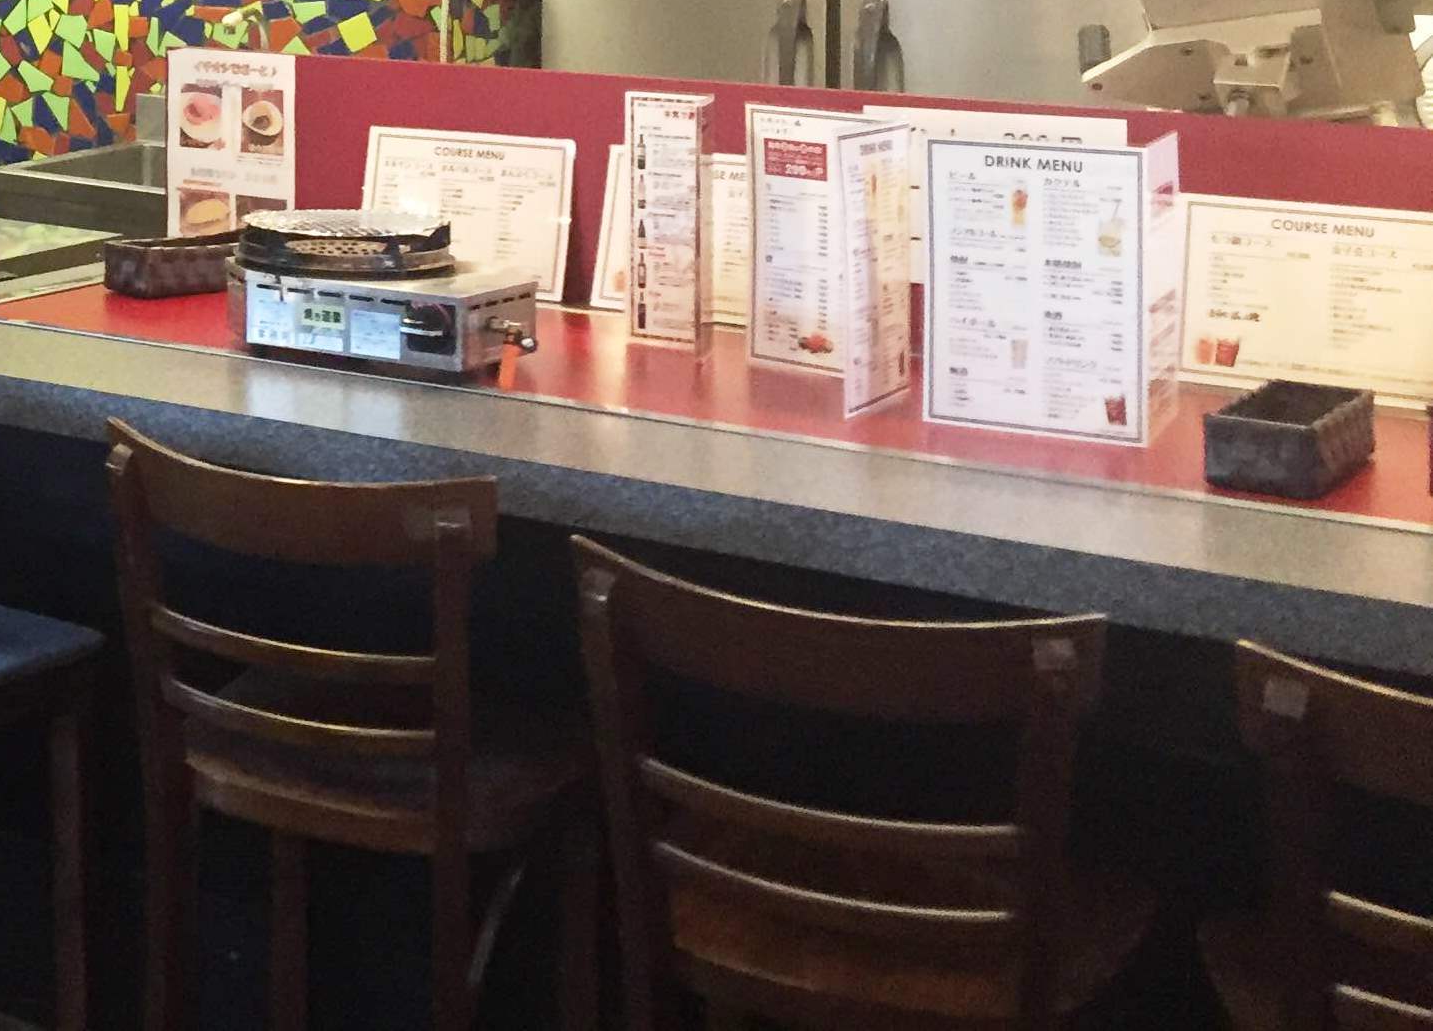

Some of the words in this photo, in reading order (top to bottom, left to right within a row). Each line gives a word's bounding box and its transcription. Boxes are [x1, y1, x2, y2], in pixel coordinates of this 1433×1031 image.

[434, 145, 474, 159] COURSE
[476, 150, 505, 161] MENU
[985, 154, 1032, 169] DRINK
[1036, 158, 1083, 173] MENU
[1271, 218, 1328, 234] COURSE
[1333, 224, 1375, 238] MENU
